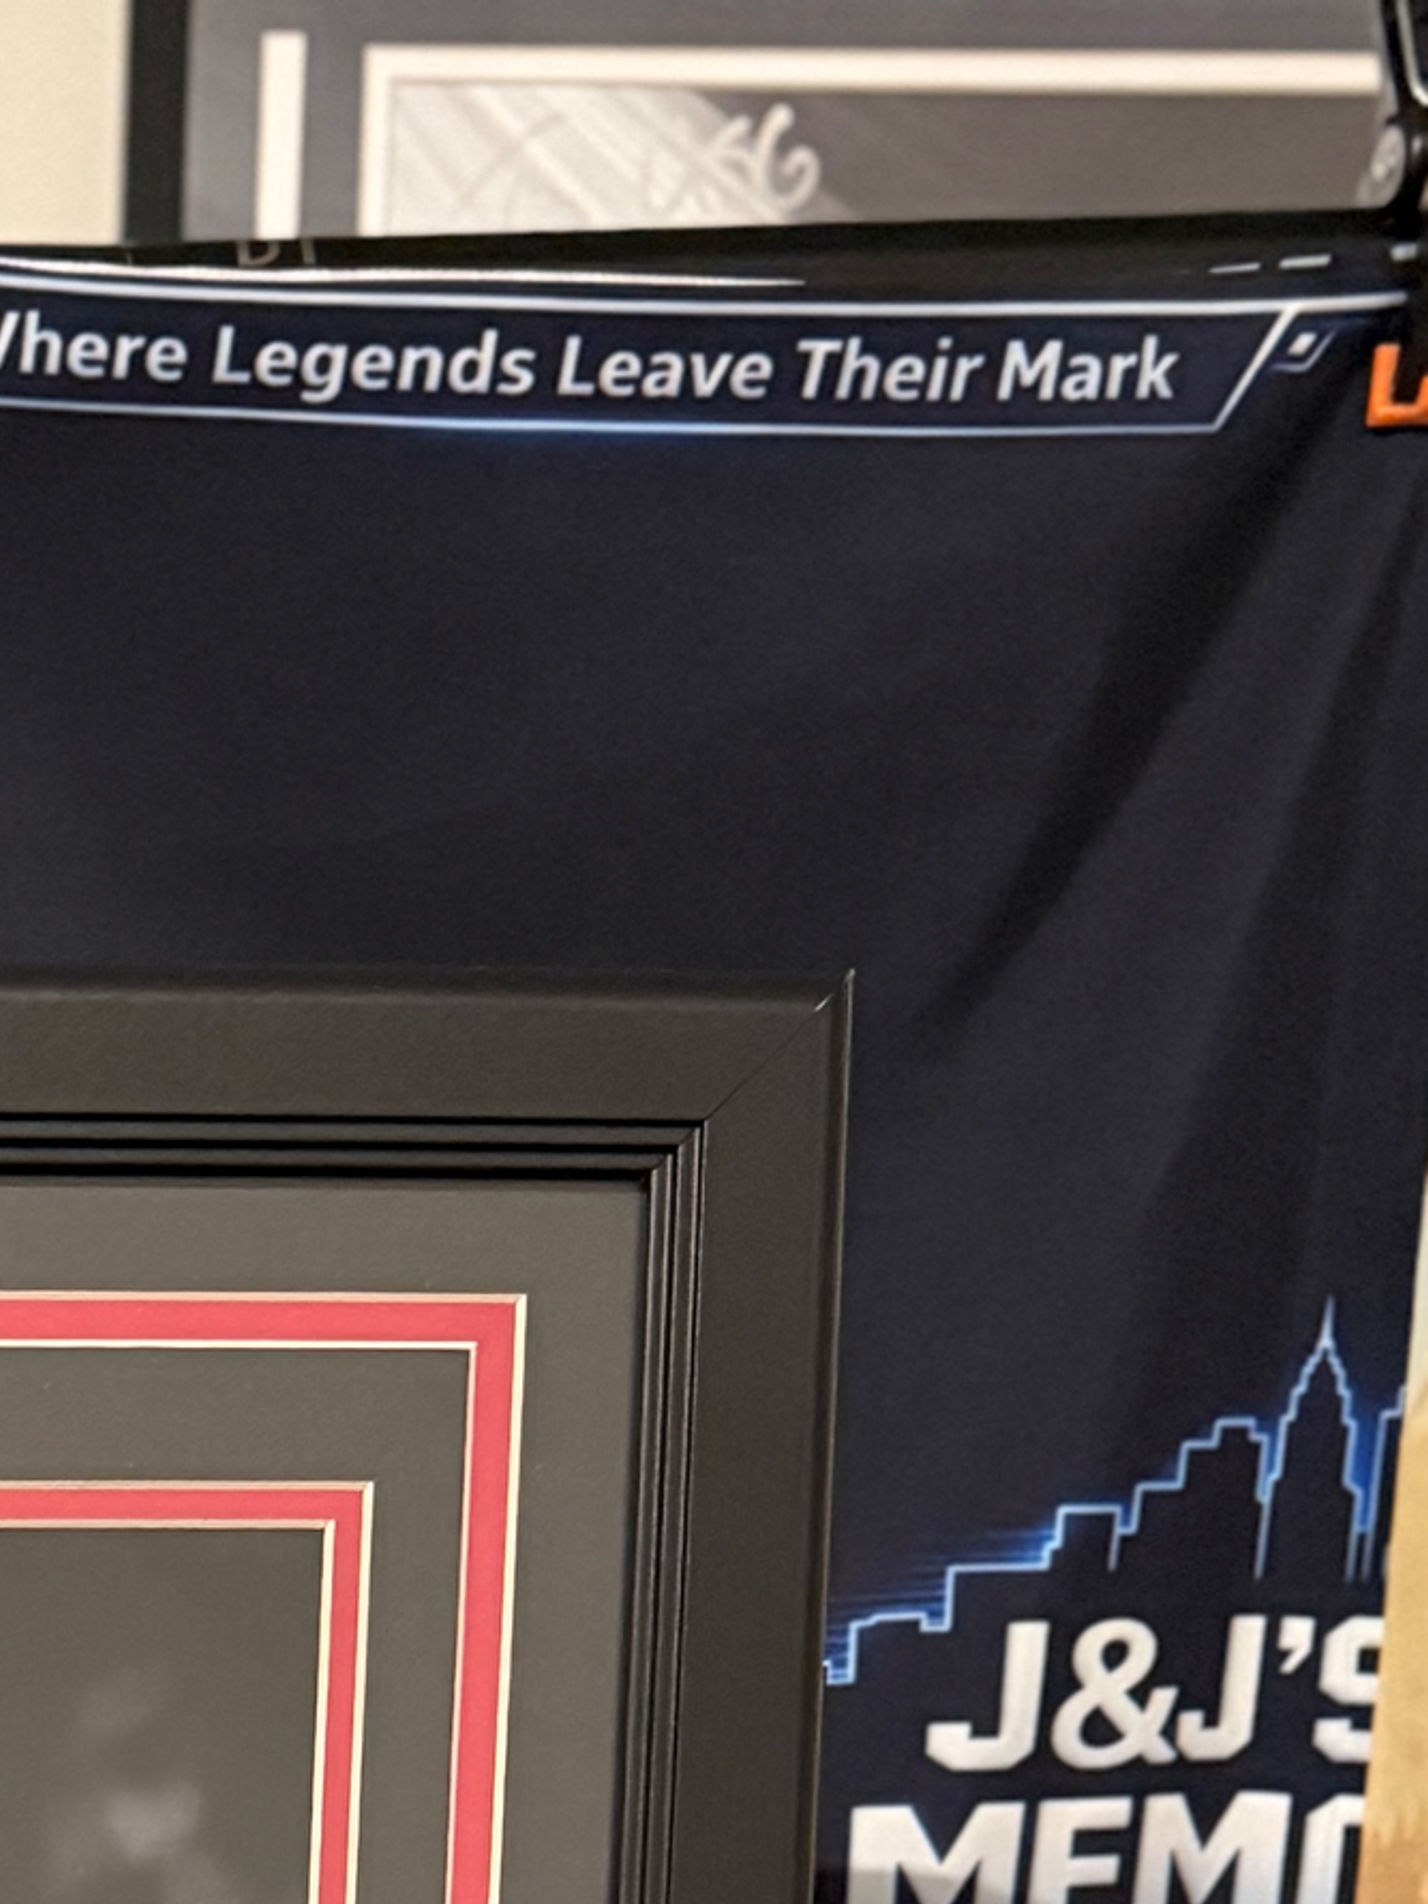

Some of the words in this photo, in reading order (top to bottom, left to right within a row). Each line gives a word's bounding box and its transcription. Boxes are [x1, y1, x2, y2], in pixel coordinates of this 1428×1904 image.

[212, 324, 537, 403] Legends
[556, 334, 773, 399] Leave
[796, 336, 985, 402] Their
[996, 330, 1179, 400] Mark
